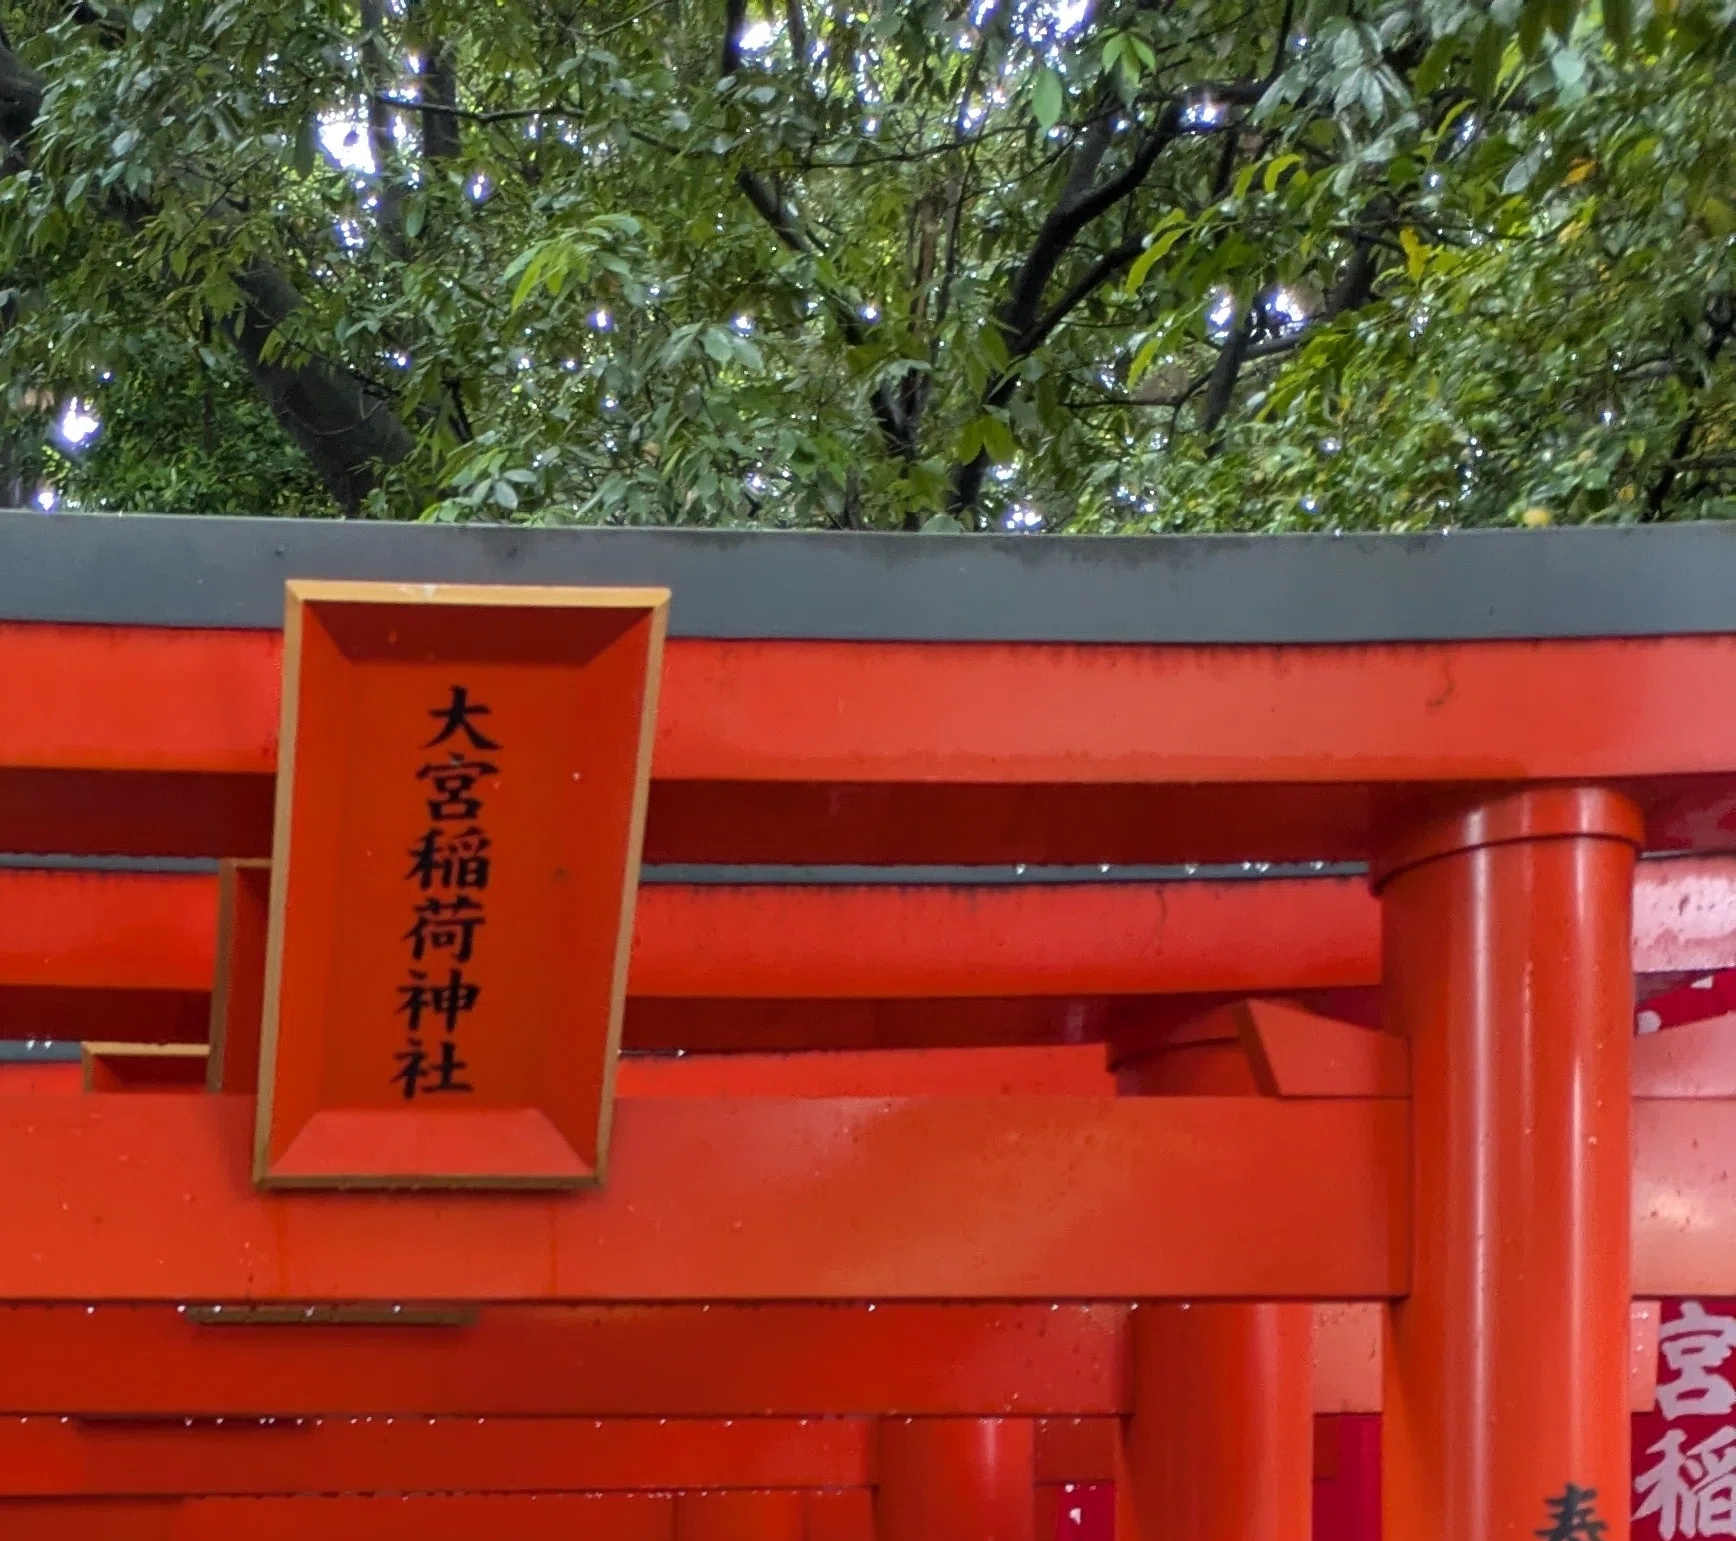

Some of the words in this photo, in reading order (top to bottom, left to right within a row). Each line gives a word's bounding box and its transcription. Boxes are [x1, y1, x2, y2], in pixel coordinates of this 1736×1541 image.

[388, 684, 504, 1101] 大宮稲荷神社
